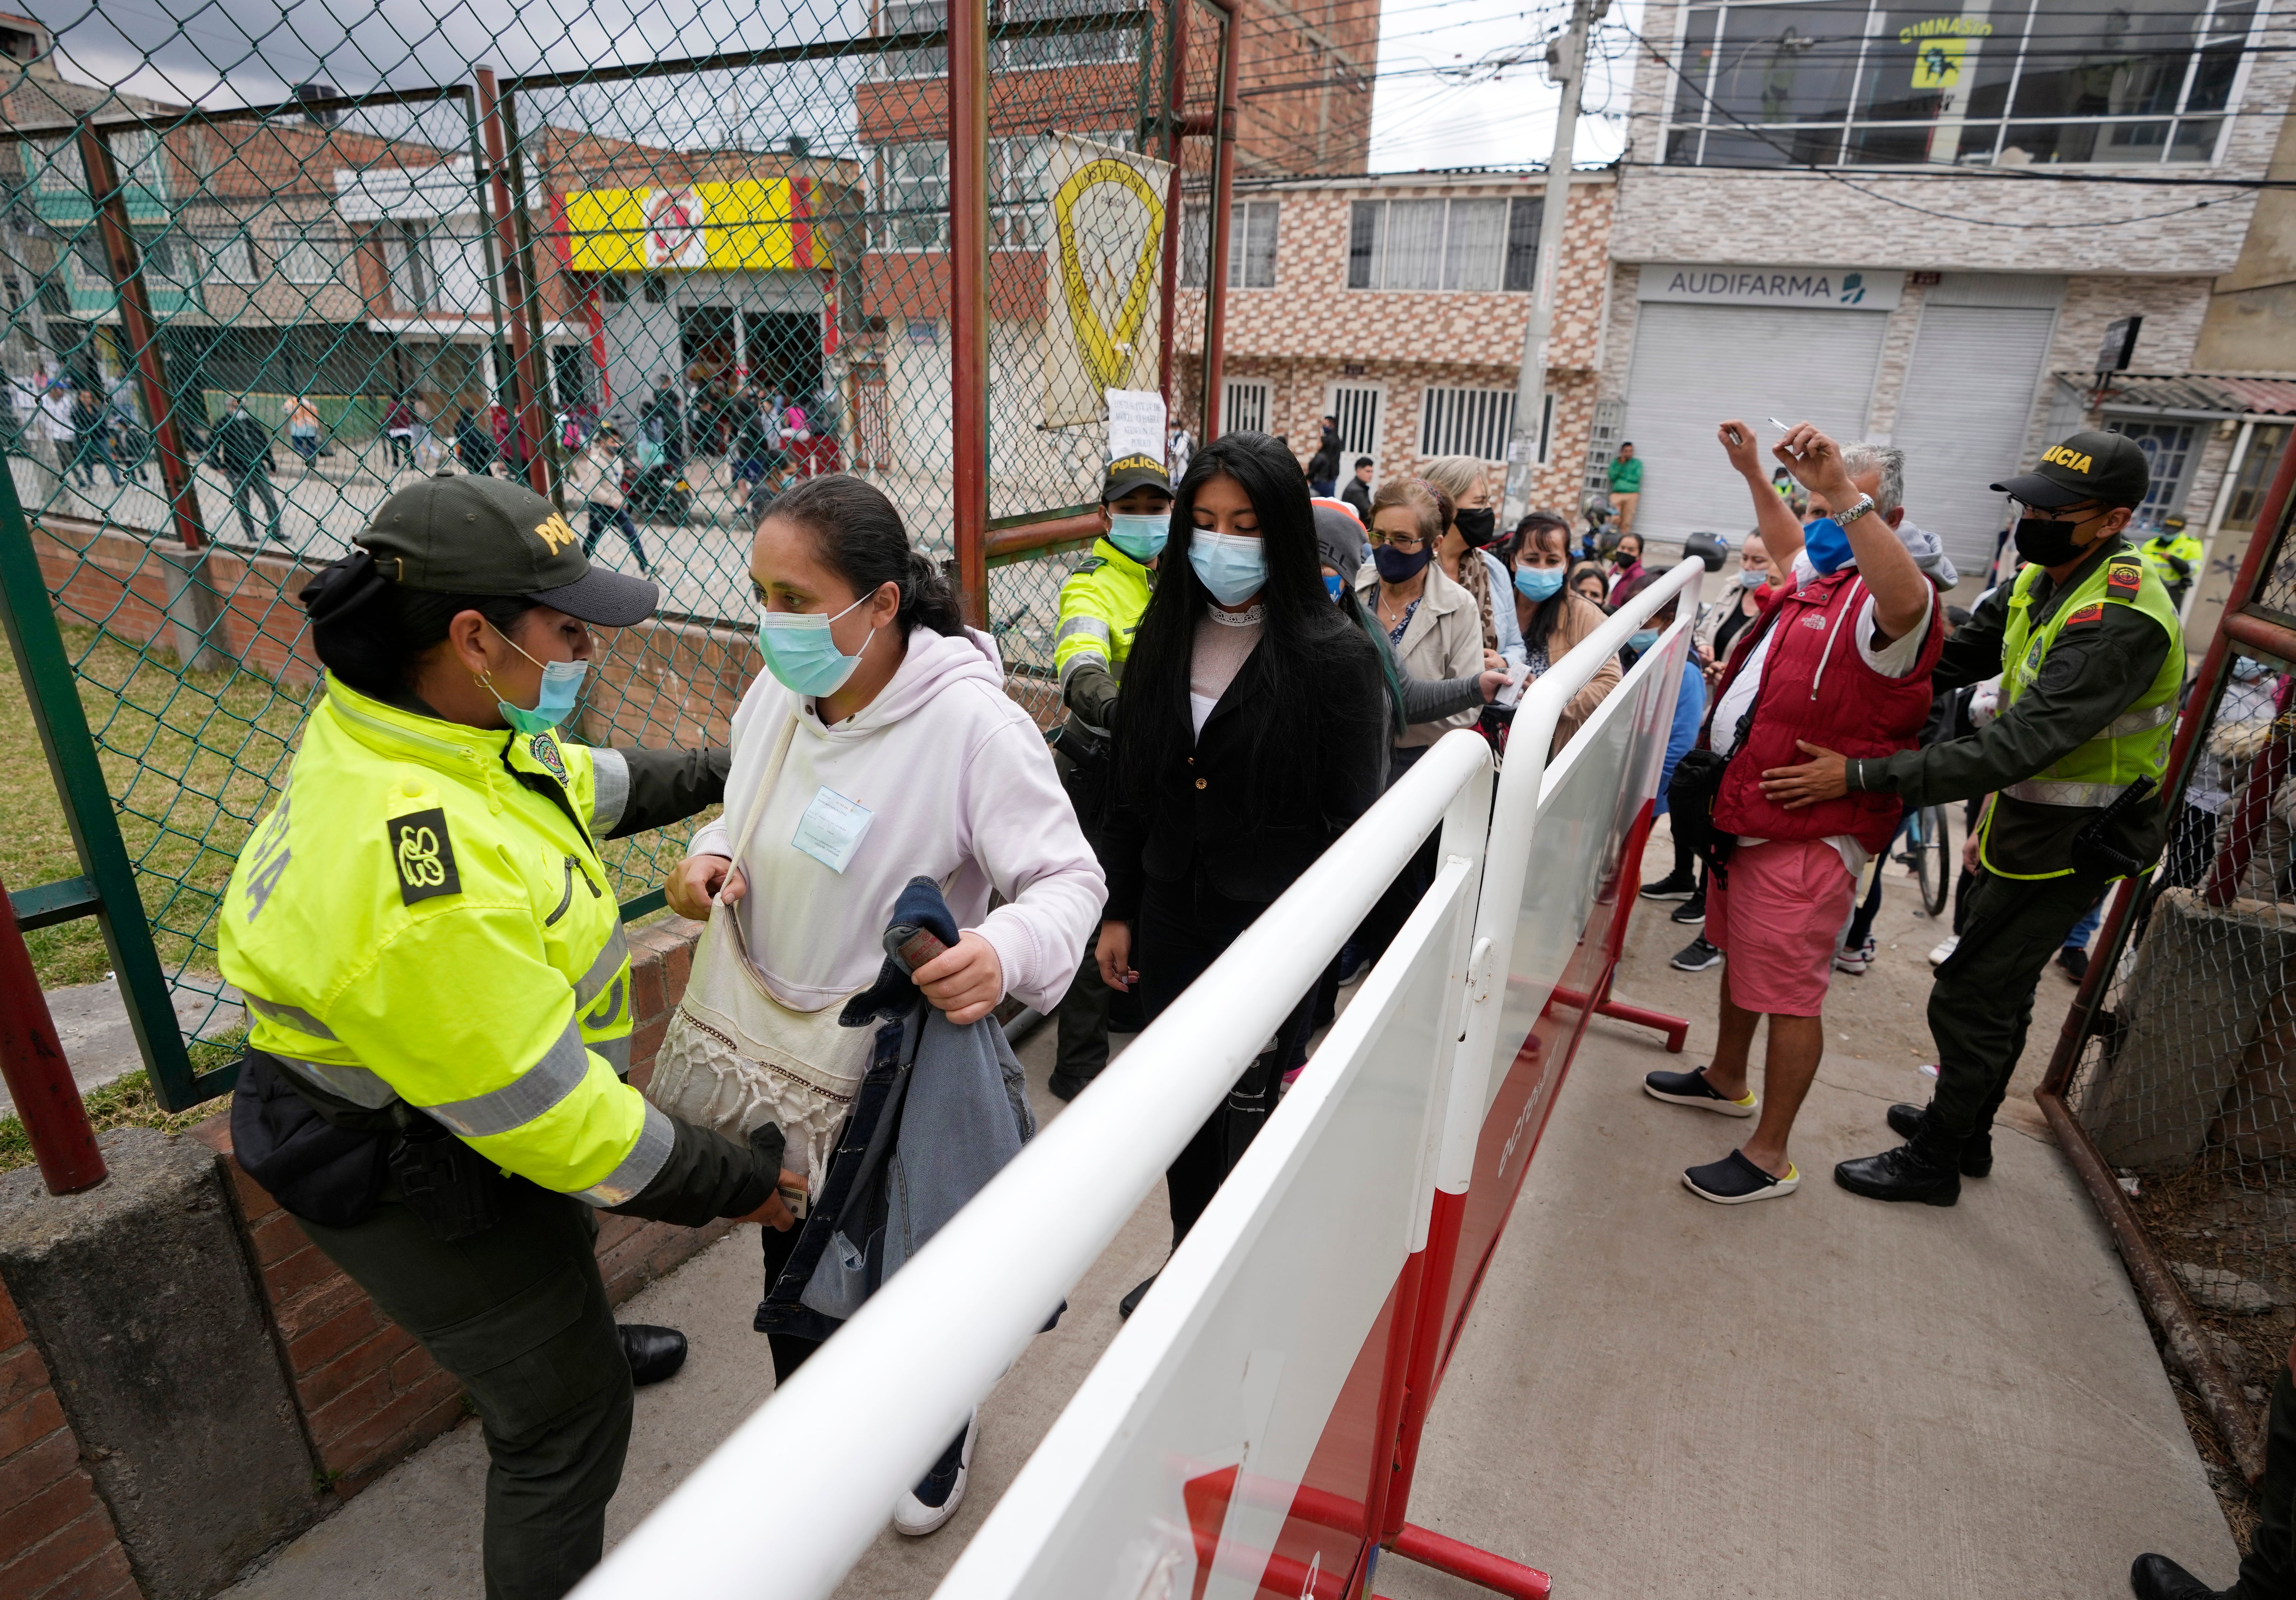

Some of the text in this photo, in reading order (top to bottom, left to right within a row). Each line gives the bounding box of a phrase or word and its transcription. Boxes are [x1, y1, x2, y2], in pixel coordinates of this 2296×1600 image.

[1899, 17, 1993, 44] GIMNASIO
[1668, 272, 1832, 298] AUDIFARMA
[1111, 456, 1168, 478] POLICIA
